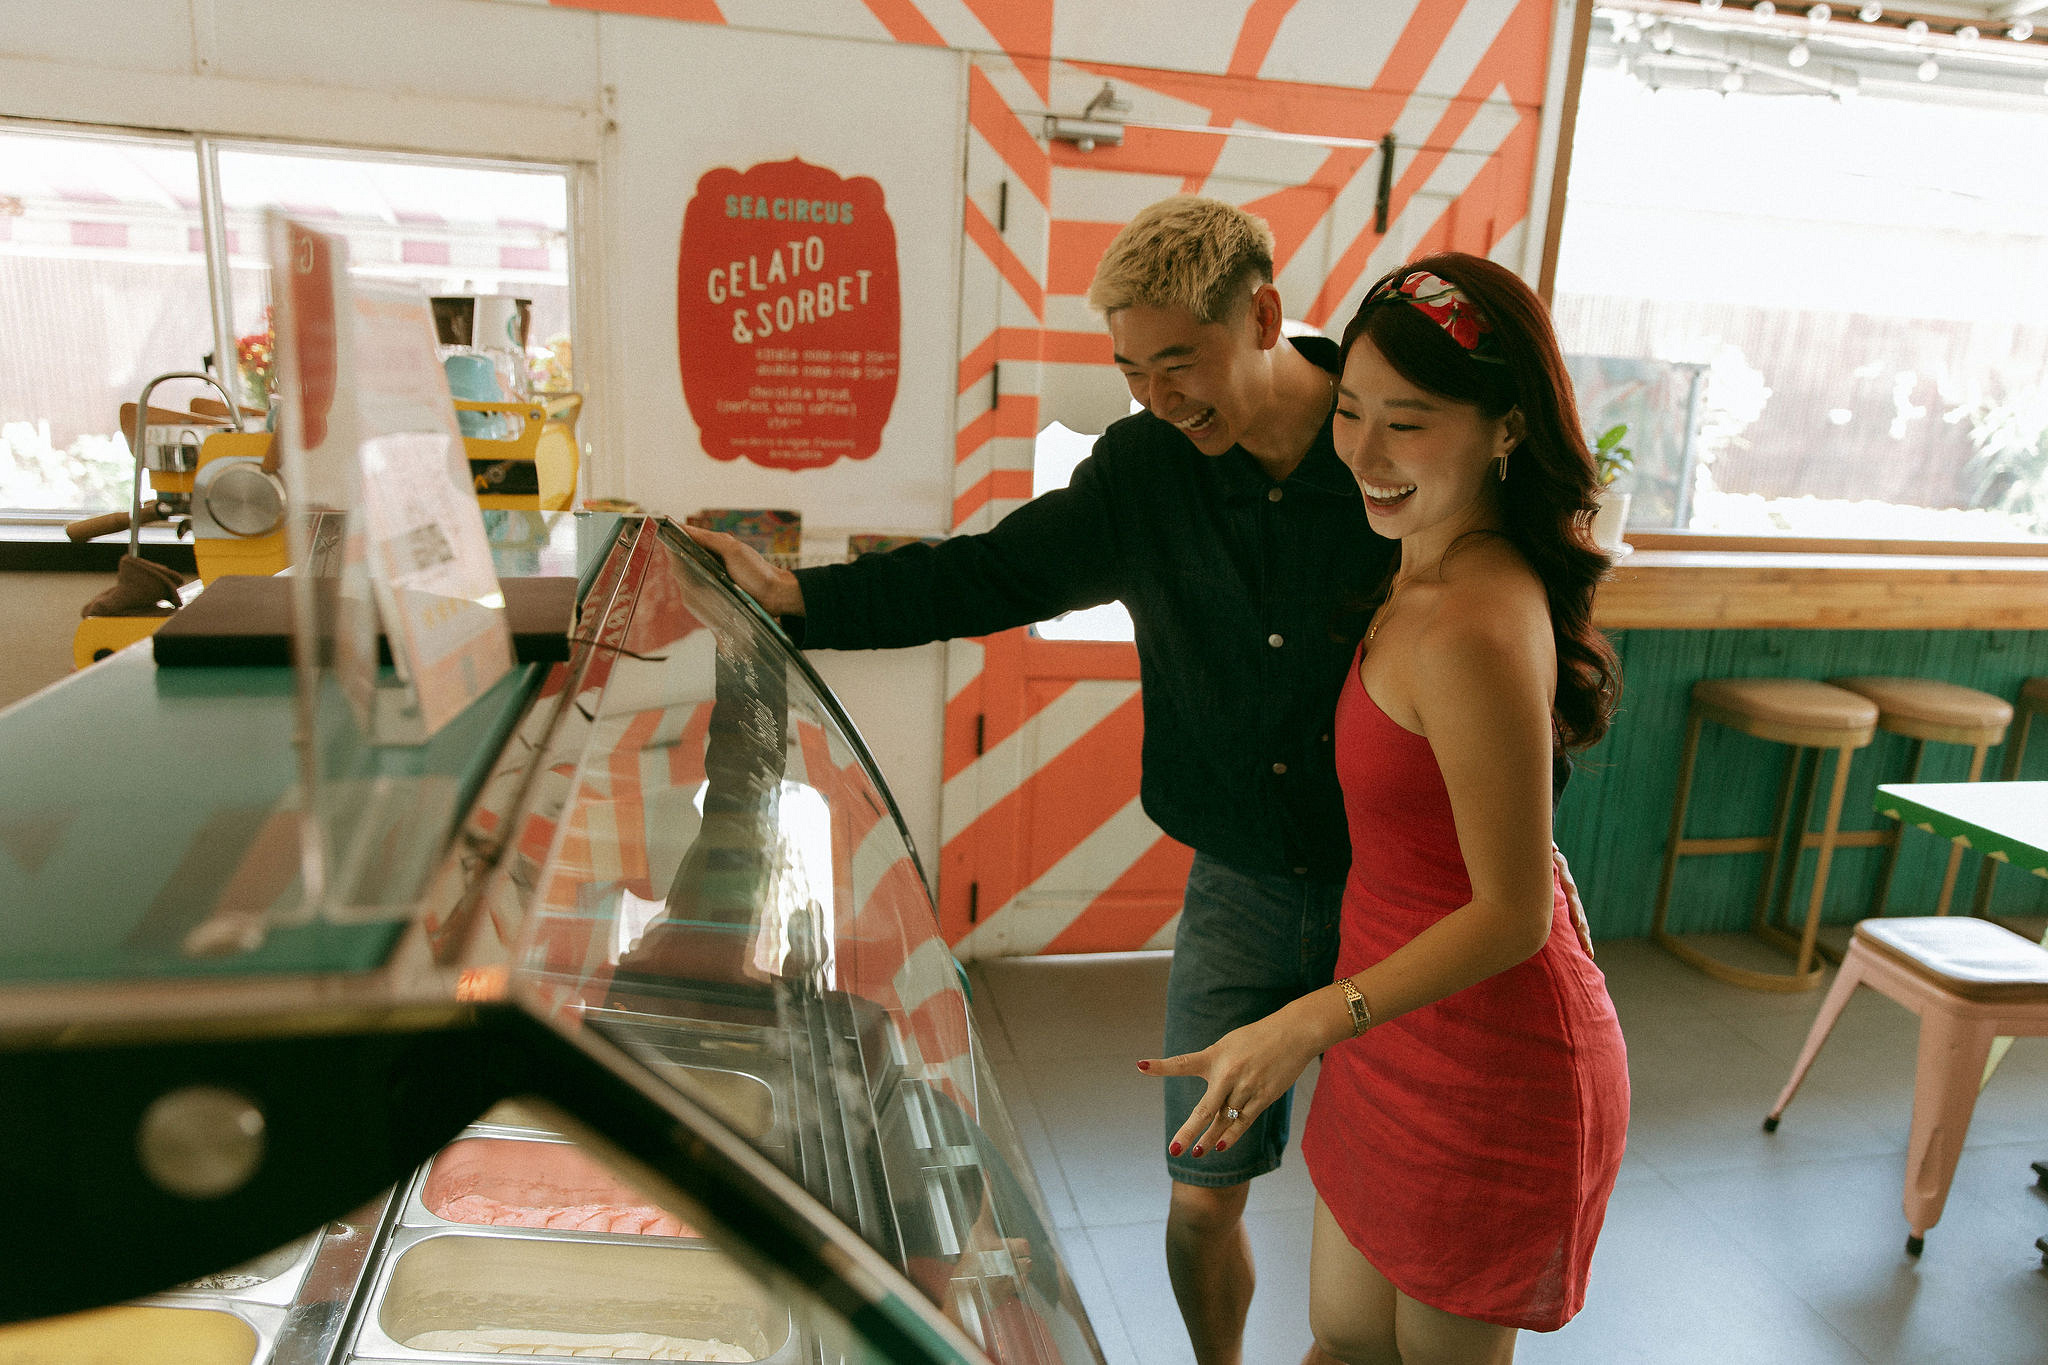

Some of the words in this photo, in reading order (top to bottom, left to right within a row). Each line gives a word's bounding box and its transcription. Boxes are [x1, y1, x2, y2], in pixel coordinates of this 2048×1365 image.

[726, 195, 769, 219] SEA
[772, 197, 854, 225] CIRCUS
[707, 236, 824, 304] GELATO
